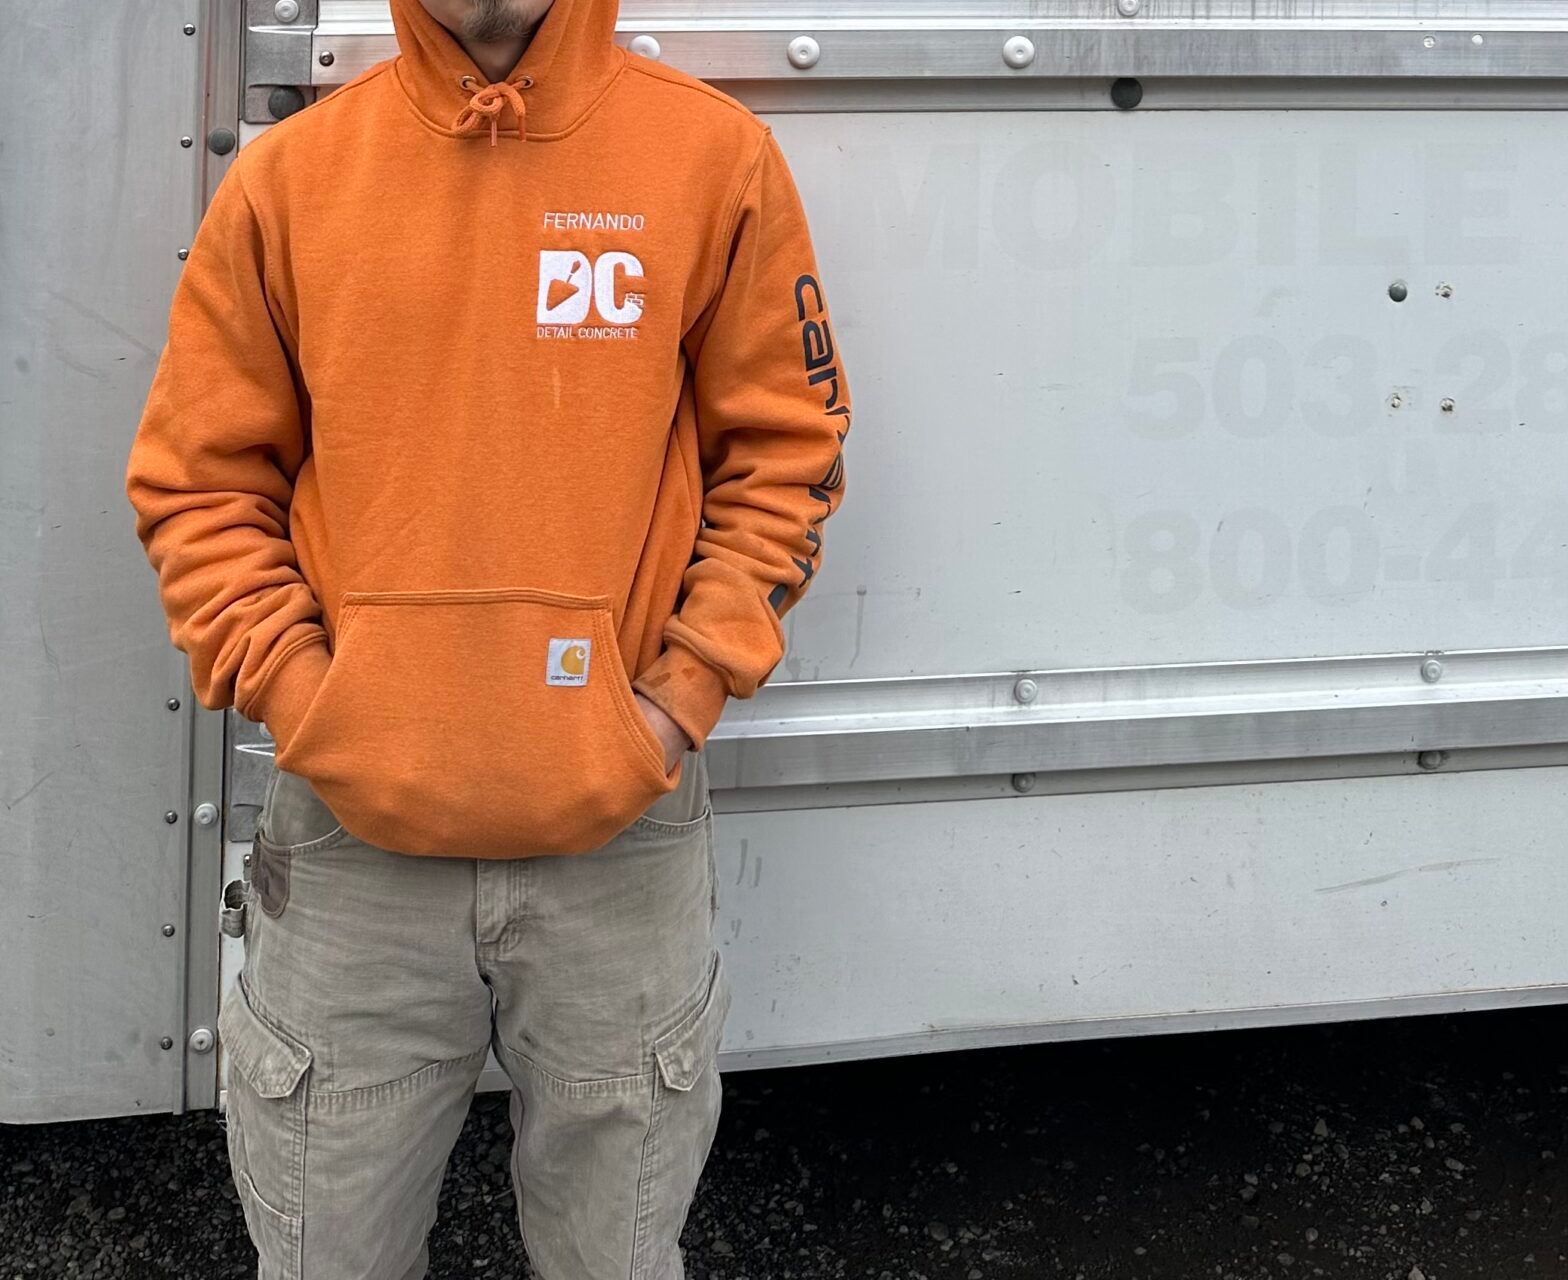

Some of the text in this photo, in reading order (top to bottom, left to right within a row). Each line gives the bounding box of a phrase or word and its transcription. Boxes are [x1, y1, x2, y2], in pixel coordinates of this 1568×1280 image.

[543, 212, 645, 231] FERNANDO
[536, 250, 645, 324] DC
[536, 327, 638, 338] DETAIL CONCRETE
